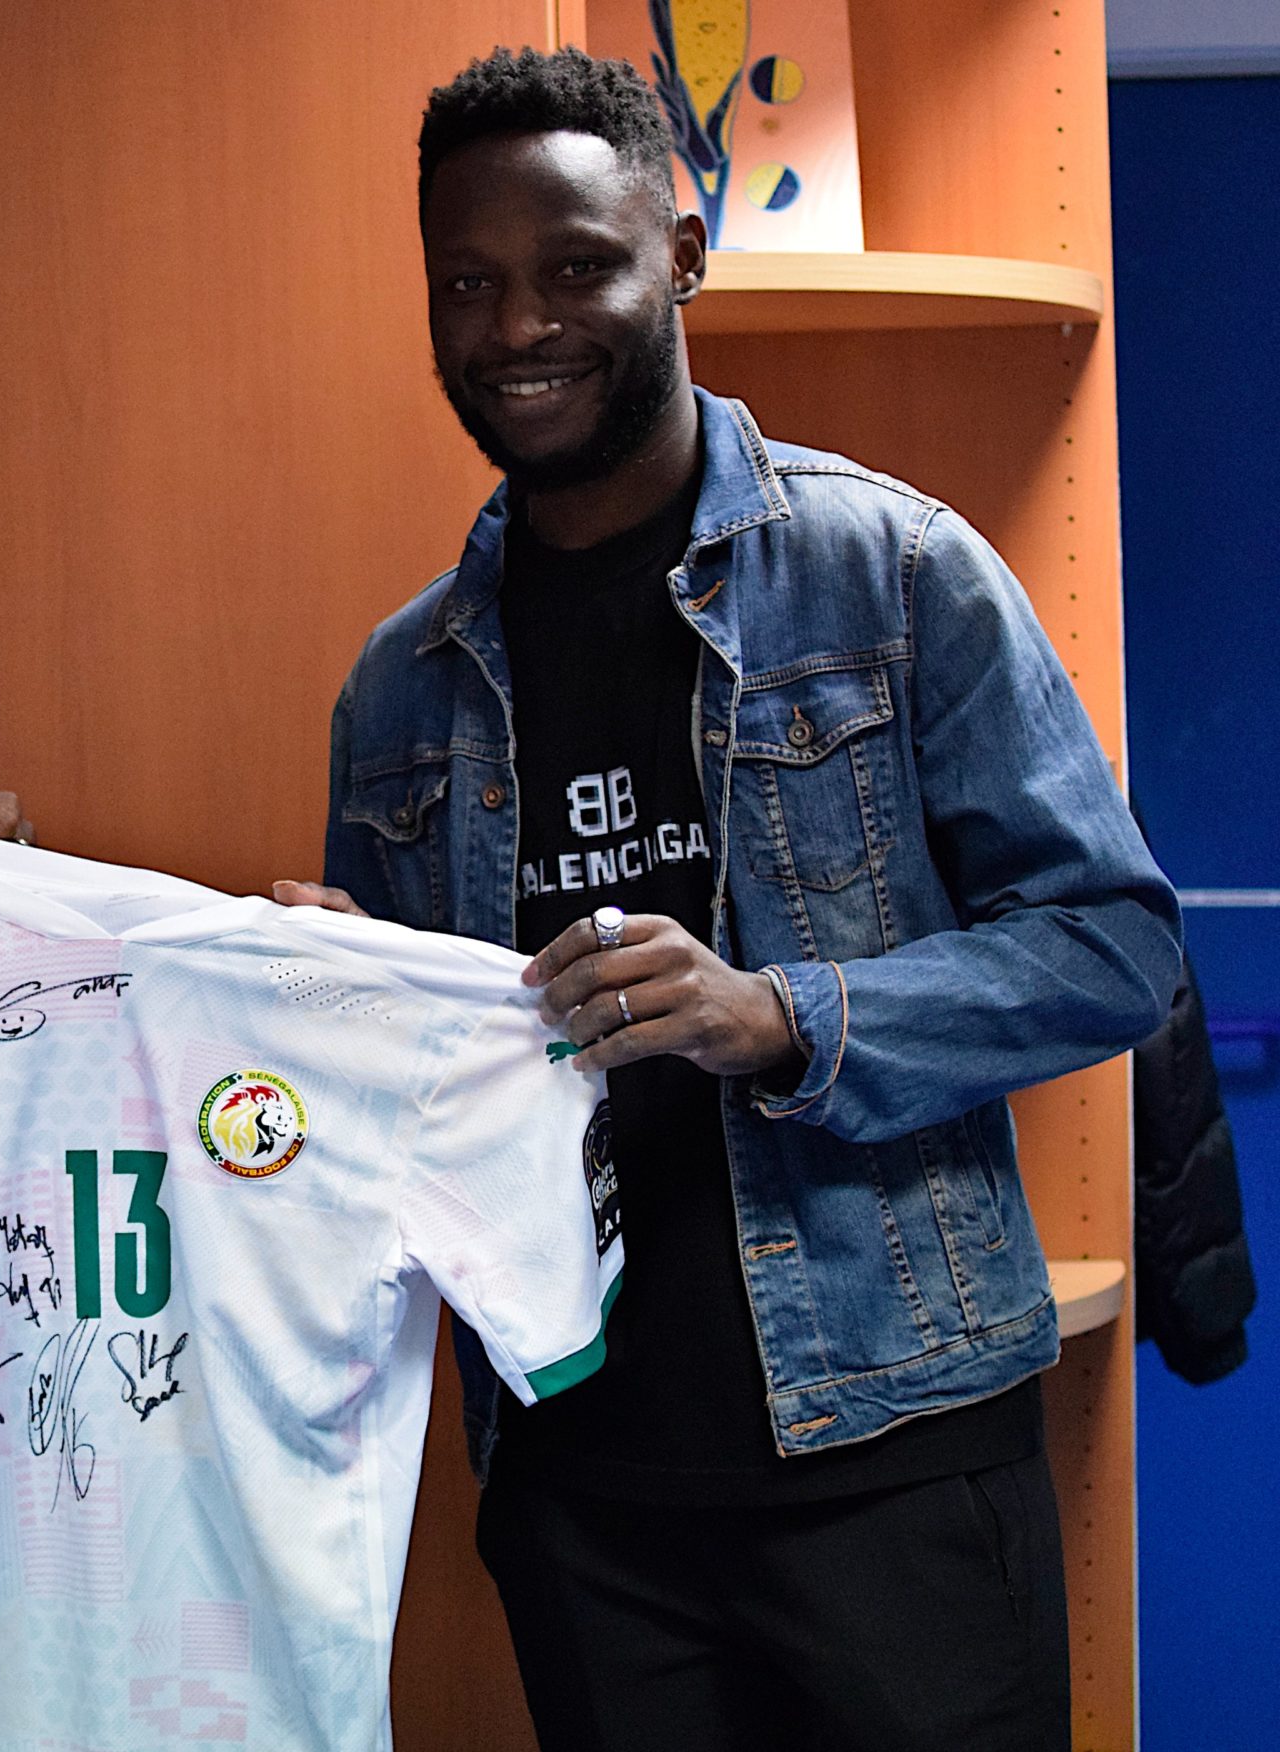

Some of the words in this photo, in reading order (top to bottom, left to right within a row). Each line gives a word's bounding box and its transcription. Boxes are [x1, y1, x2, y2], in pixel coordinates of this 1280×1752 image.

[248, 1072, 306, 1126] SÉNÉGALAISE
[229, 1157, 288, 1177] FOOTBALL
[287, 1143, 300, 1156] DE
[66, 1150, 172, 1320] 13
